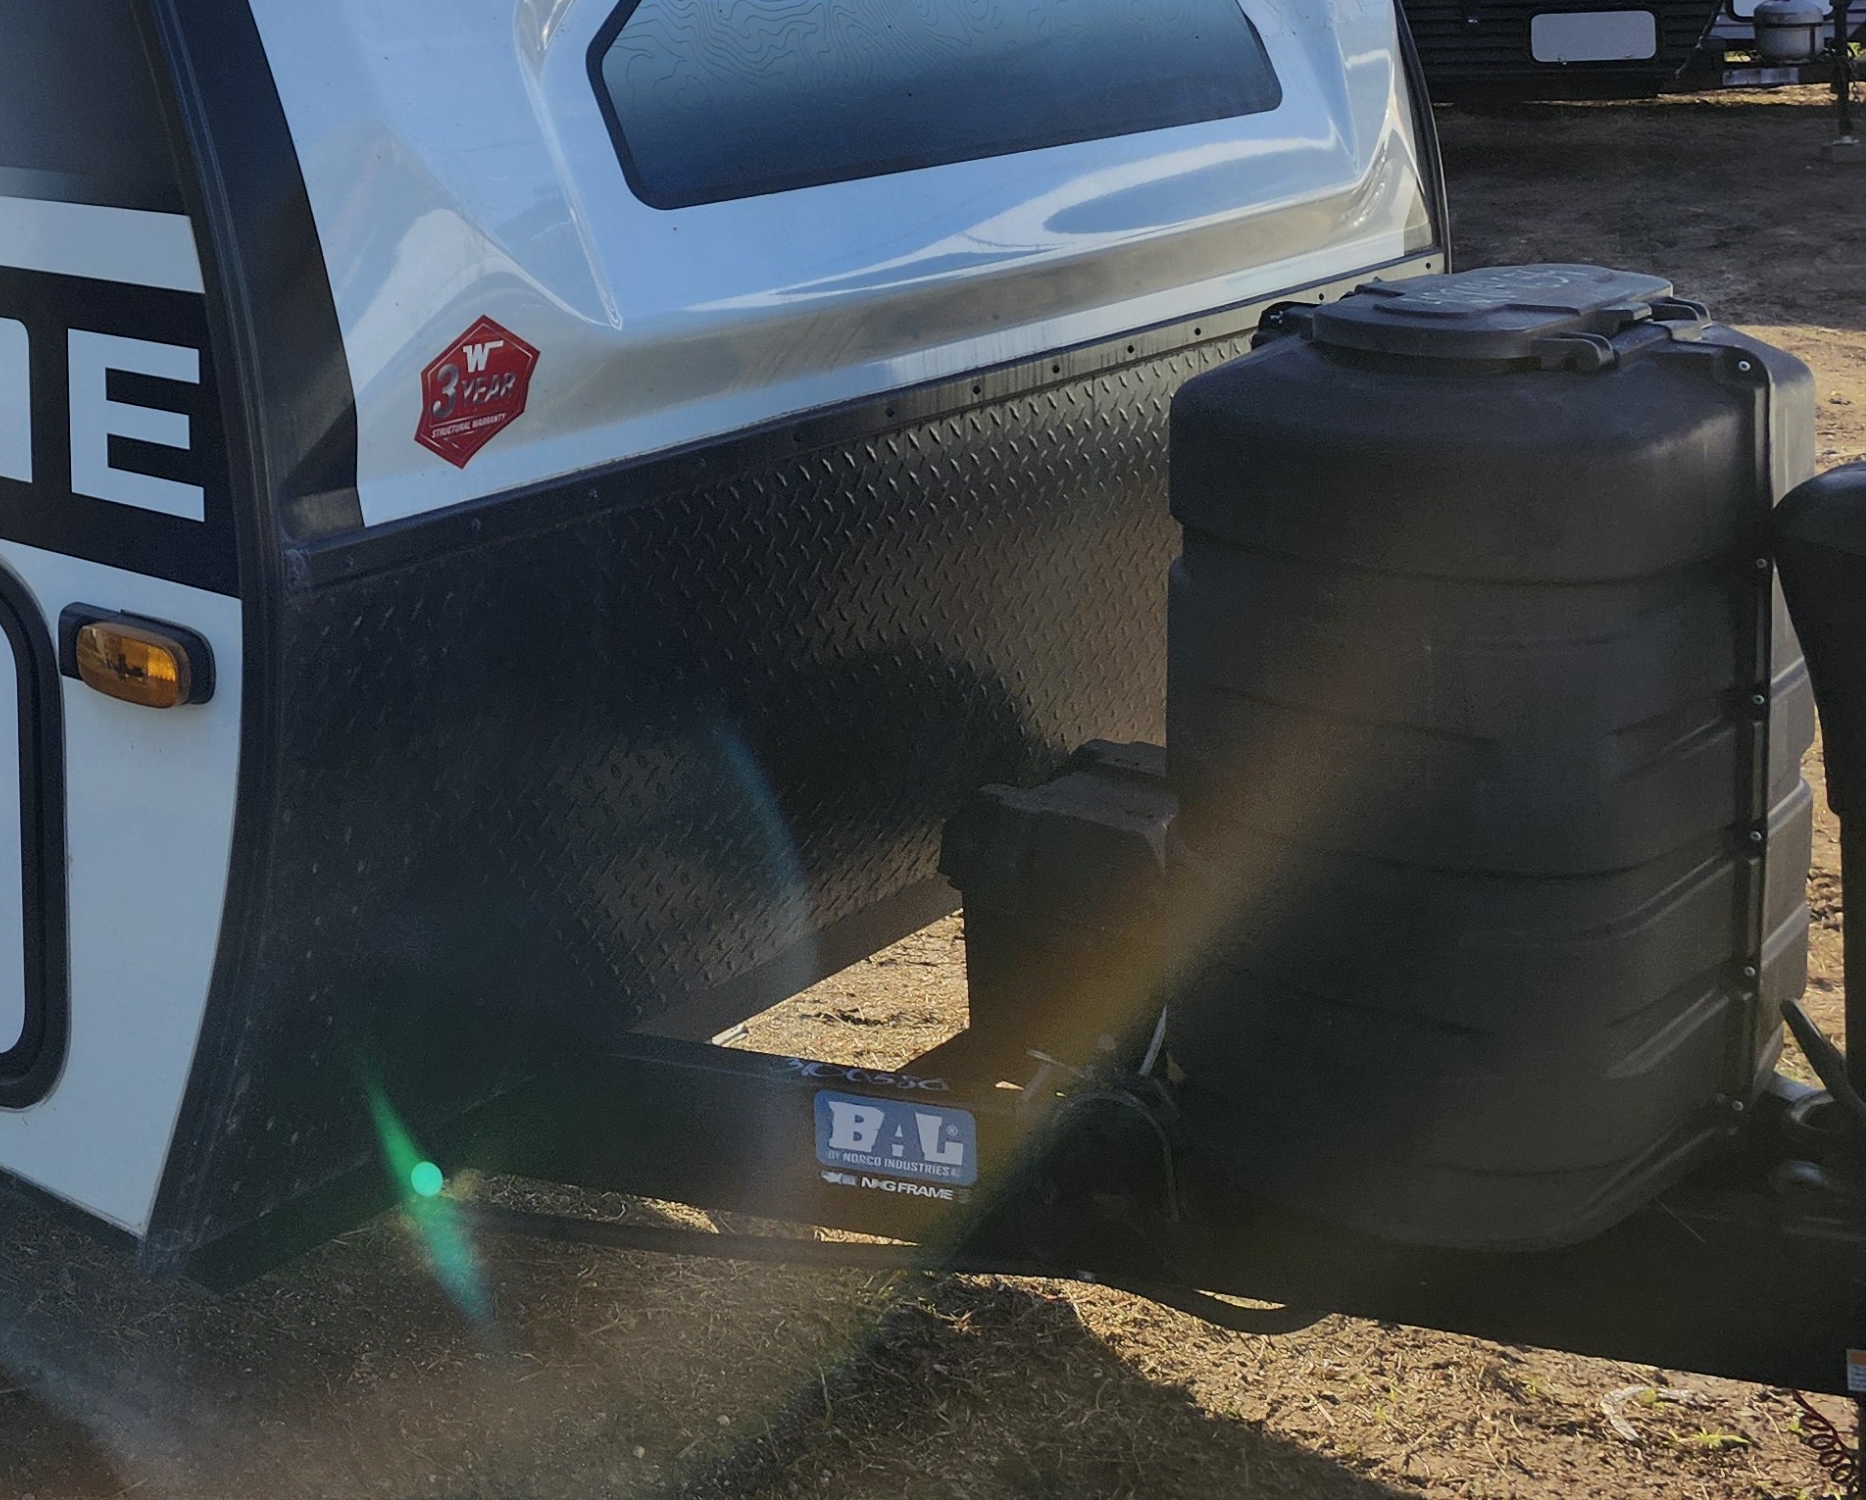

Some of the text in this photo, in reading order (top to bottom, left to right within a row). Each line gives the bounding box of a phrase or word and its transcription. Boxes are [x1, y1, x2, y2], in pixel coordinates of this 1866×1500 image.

[431, 363, 517, 418] 3 YEAR
[828, 1101, 964, 1166] BAL
[843, 1152, 882, 1166] NORCO
[884, 1158, 950, 1176] INDUSTRIES
[897, 1182, 954, 1201] FRAME
